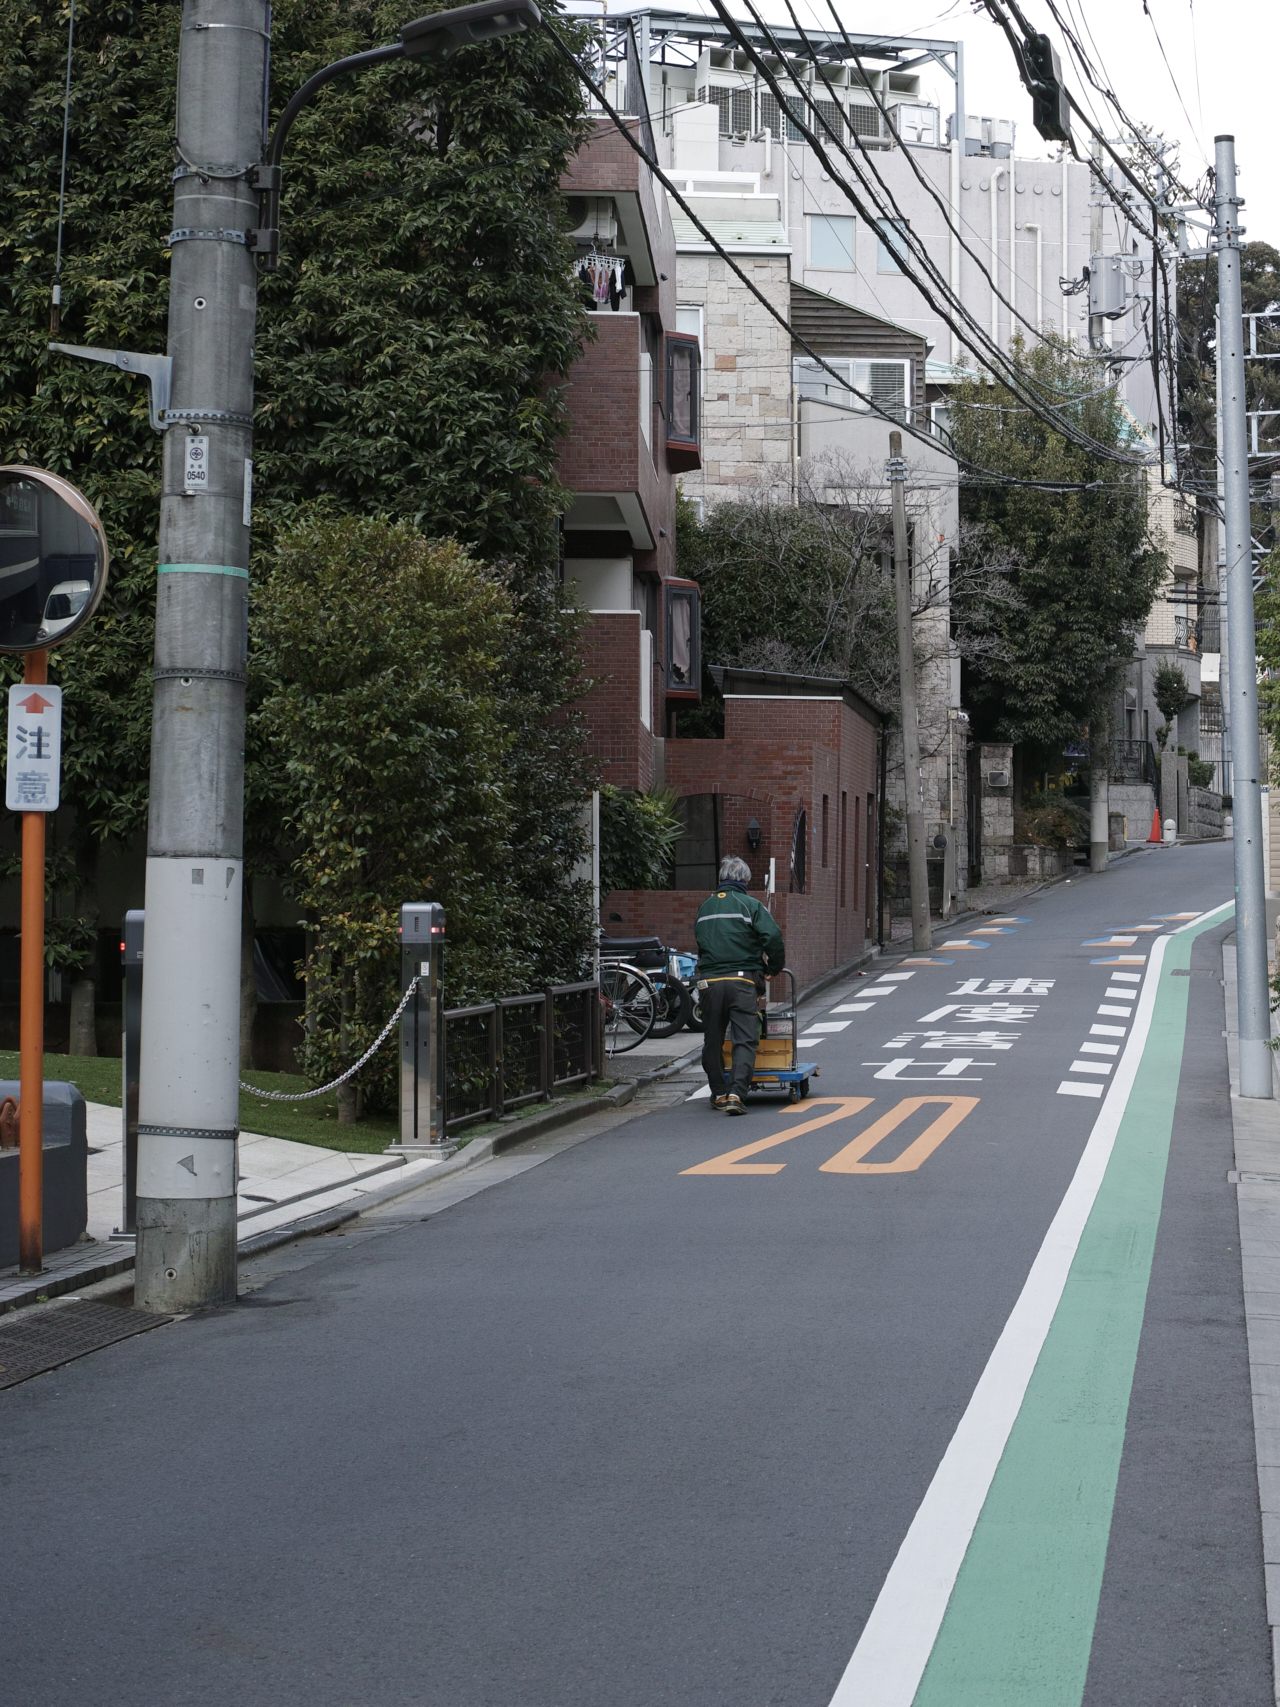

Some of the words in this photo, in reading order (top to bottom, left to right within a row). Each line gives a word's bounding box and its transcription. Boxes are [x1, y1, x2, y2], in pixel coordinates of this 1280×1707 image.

[187, 471, 205, 480] 0540
[15, 725, 51, 804] 注意
[861, 978, 1056, 1081] 速度落せ
[677, 1096, 981, 1175] 20
